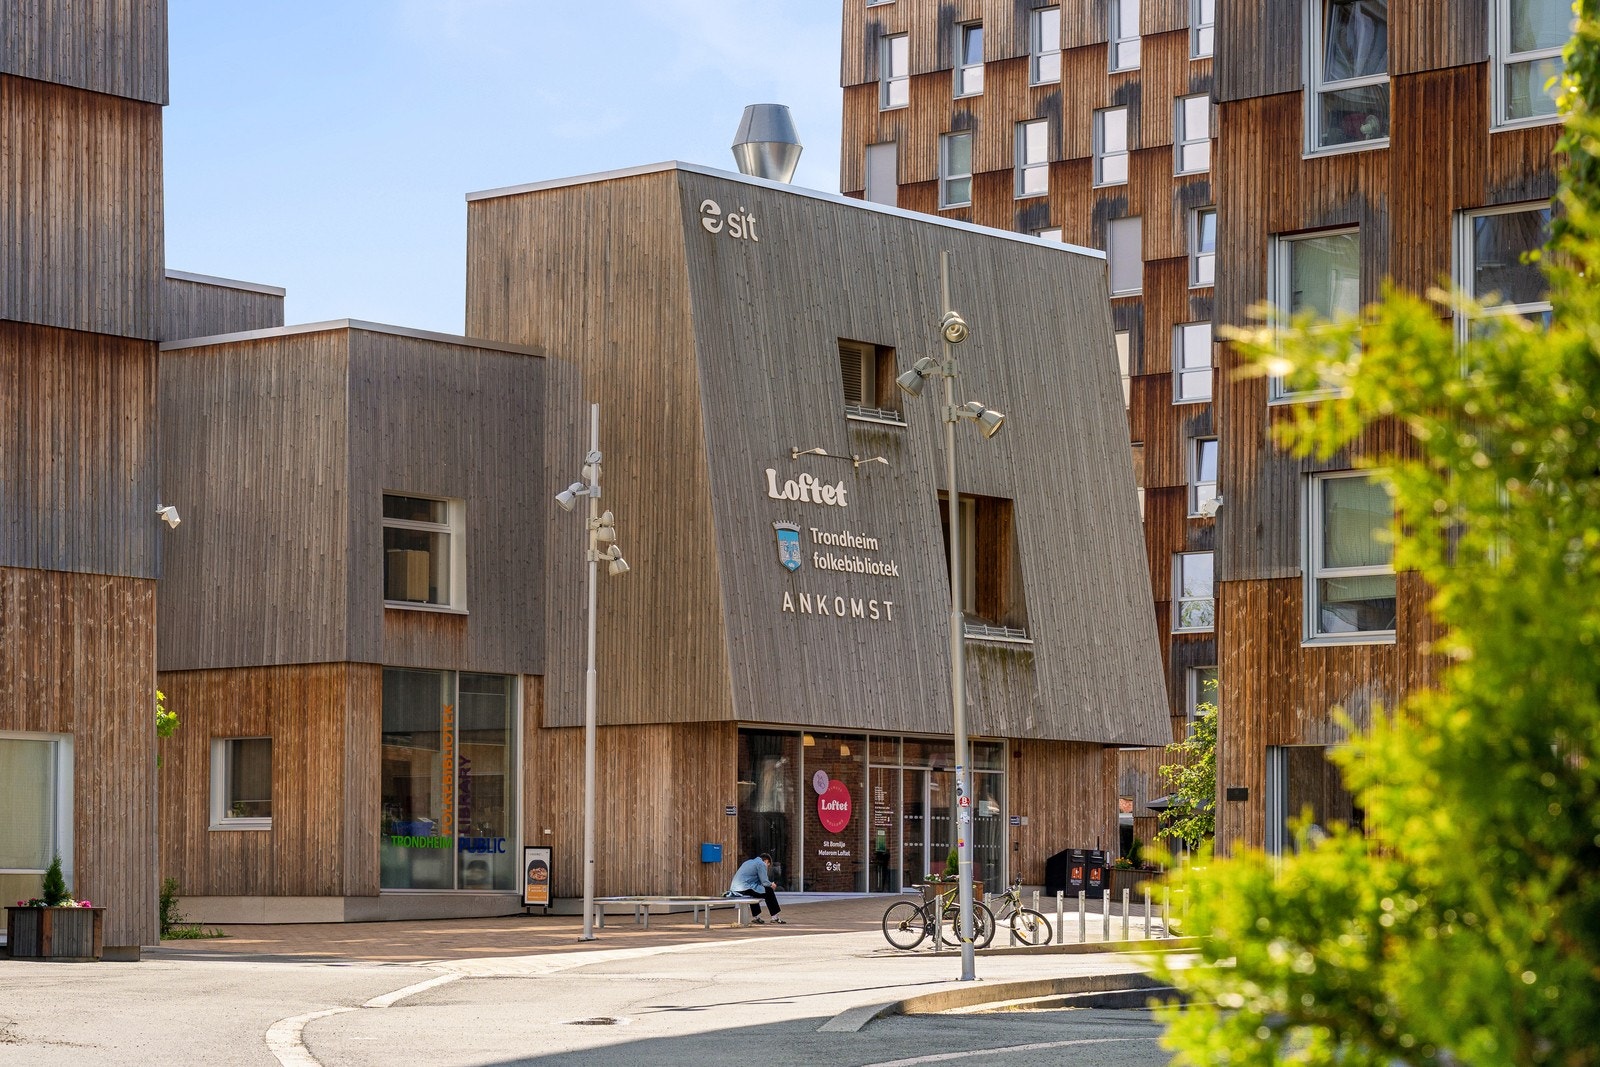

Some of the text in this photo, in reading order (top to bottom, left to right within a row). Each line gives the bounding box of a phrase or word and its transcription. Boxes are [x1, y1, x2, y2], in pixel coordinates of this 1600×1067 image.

[727, 206, 758, 242] sit
[765, 468, 848, 507] Loftet
[810, 527, 879, 551] Trondheim
[813, 551, 899, 577] folkebibliotek
[782, 591, 893, 621] ANKOMST
[441, 703, 454, 836] FOLKEBIBLIOTEK
[458, 754, 472, 836] LIBRARY
[821, 799, 848, 811] Loftet
[391, 835, 453, 849] TRONDHEIM
[458, 837, 506, 854] PUBLIC
[832, 861, 841, 871] sit
